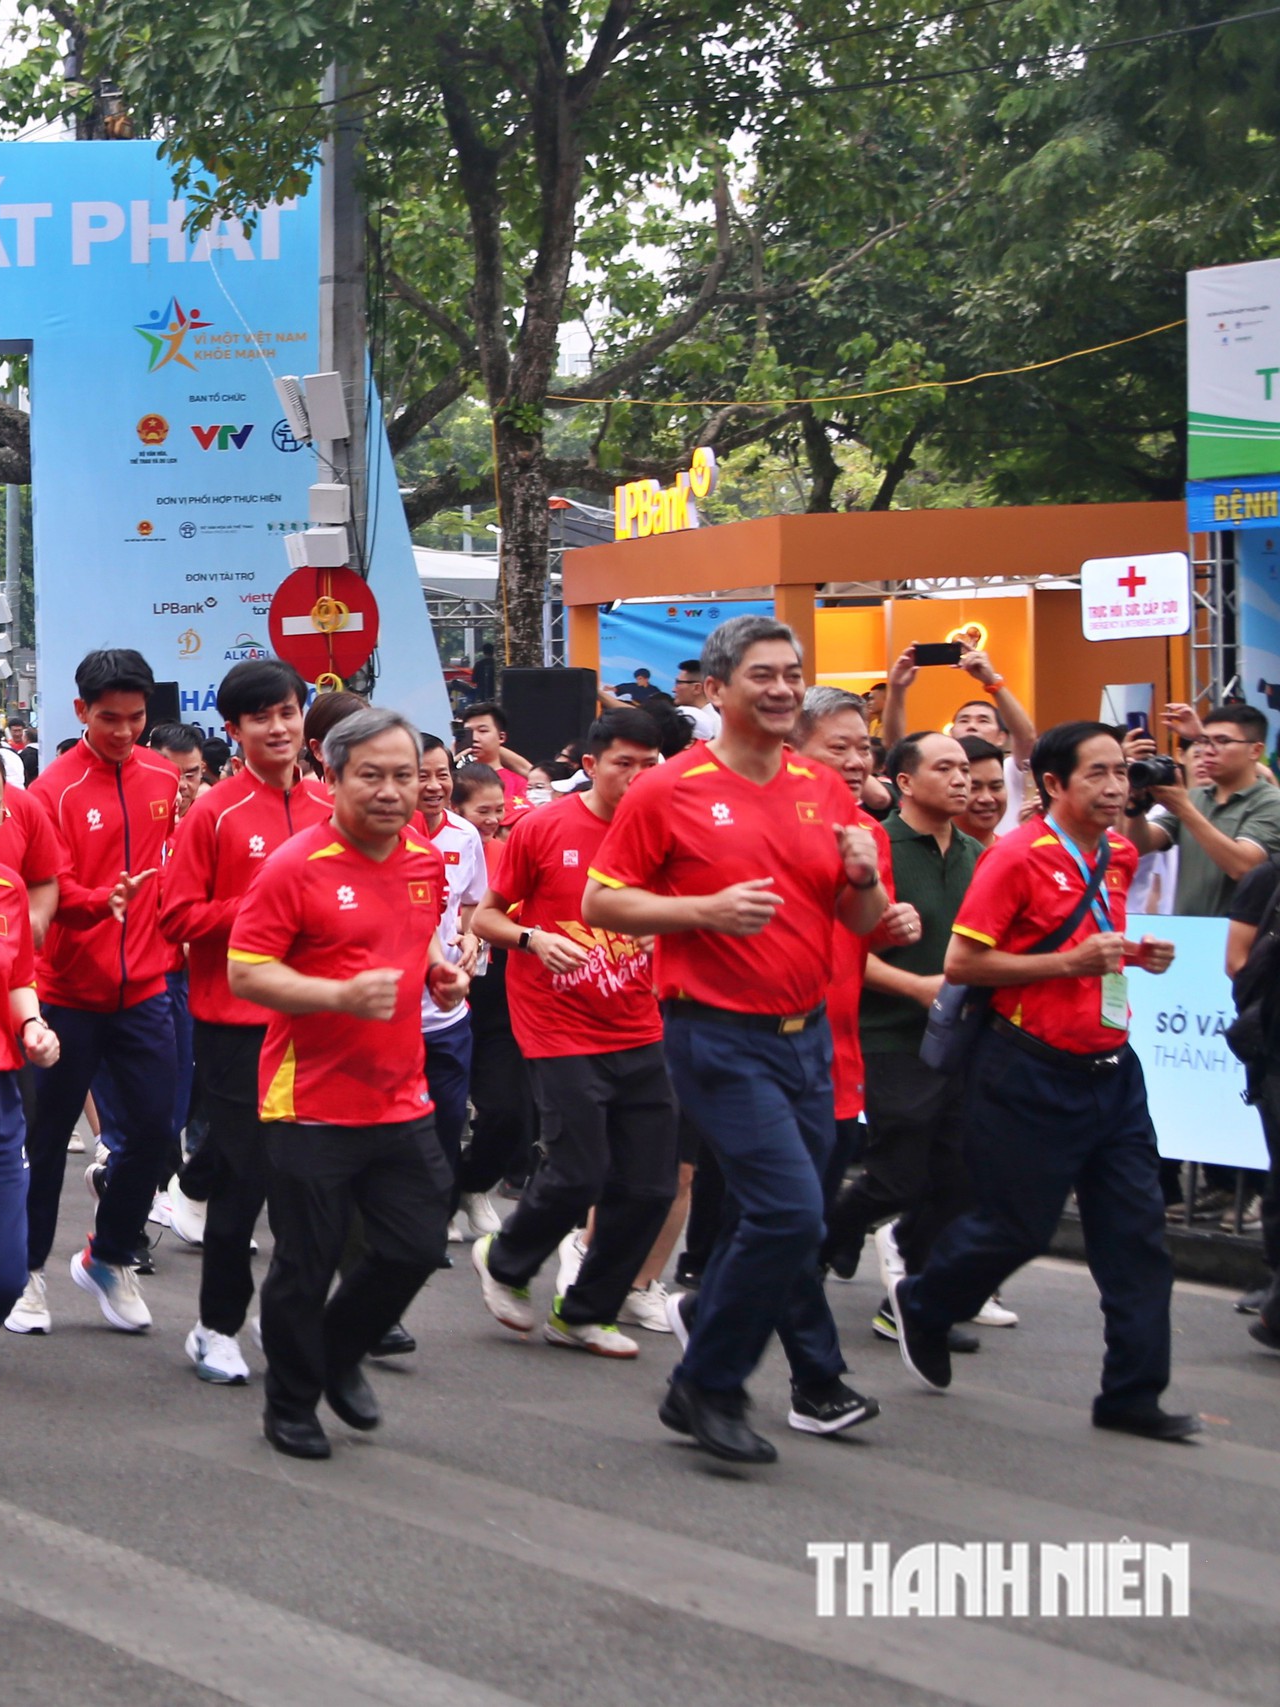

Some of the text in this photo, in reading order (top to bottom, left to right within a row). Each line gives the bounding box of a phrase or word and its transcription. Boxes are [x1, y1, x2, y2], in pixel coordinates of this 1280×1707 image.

[210, 331, 240, 347] MỘT
[276, 332, 308, 342] NAM
[235, 349, 276, 361] MẠNH
[189, 395, 209, 403] BAN
[222, 393, 247, 402] CHỨC
[190, 424, 255, 451] VTV
[156, 496, 177, 505] ĐƠN
[189, 494, 211, 504] PHỐI
[212, 495, 232, 504] HỢP
[615, 472, 699, 541] LPBank
[1214, 487, 1278, 526] BỆNH
[185, 573, 208, 582] ĐƠN
[220, 571, 234, 581] TÀI
[235, 571, 255, 581] TRỢ
[239, 592, 274, 603] viett
[153, 602, 204, 615] LPBank
[683, 609, 703, 618] VTV
[1156, 1004, 1228, 1038] SỞ VĂ
[1153, 1042, 1228, 1074] THÀNH
